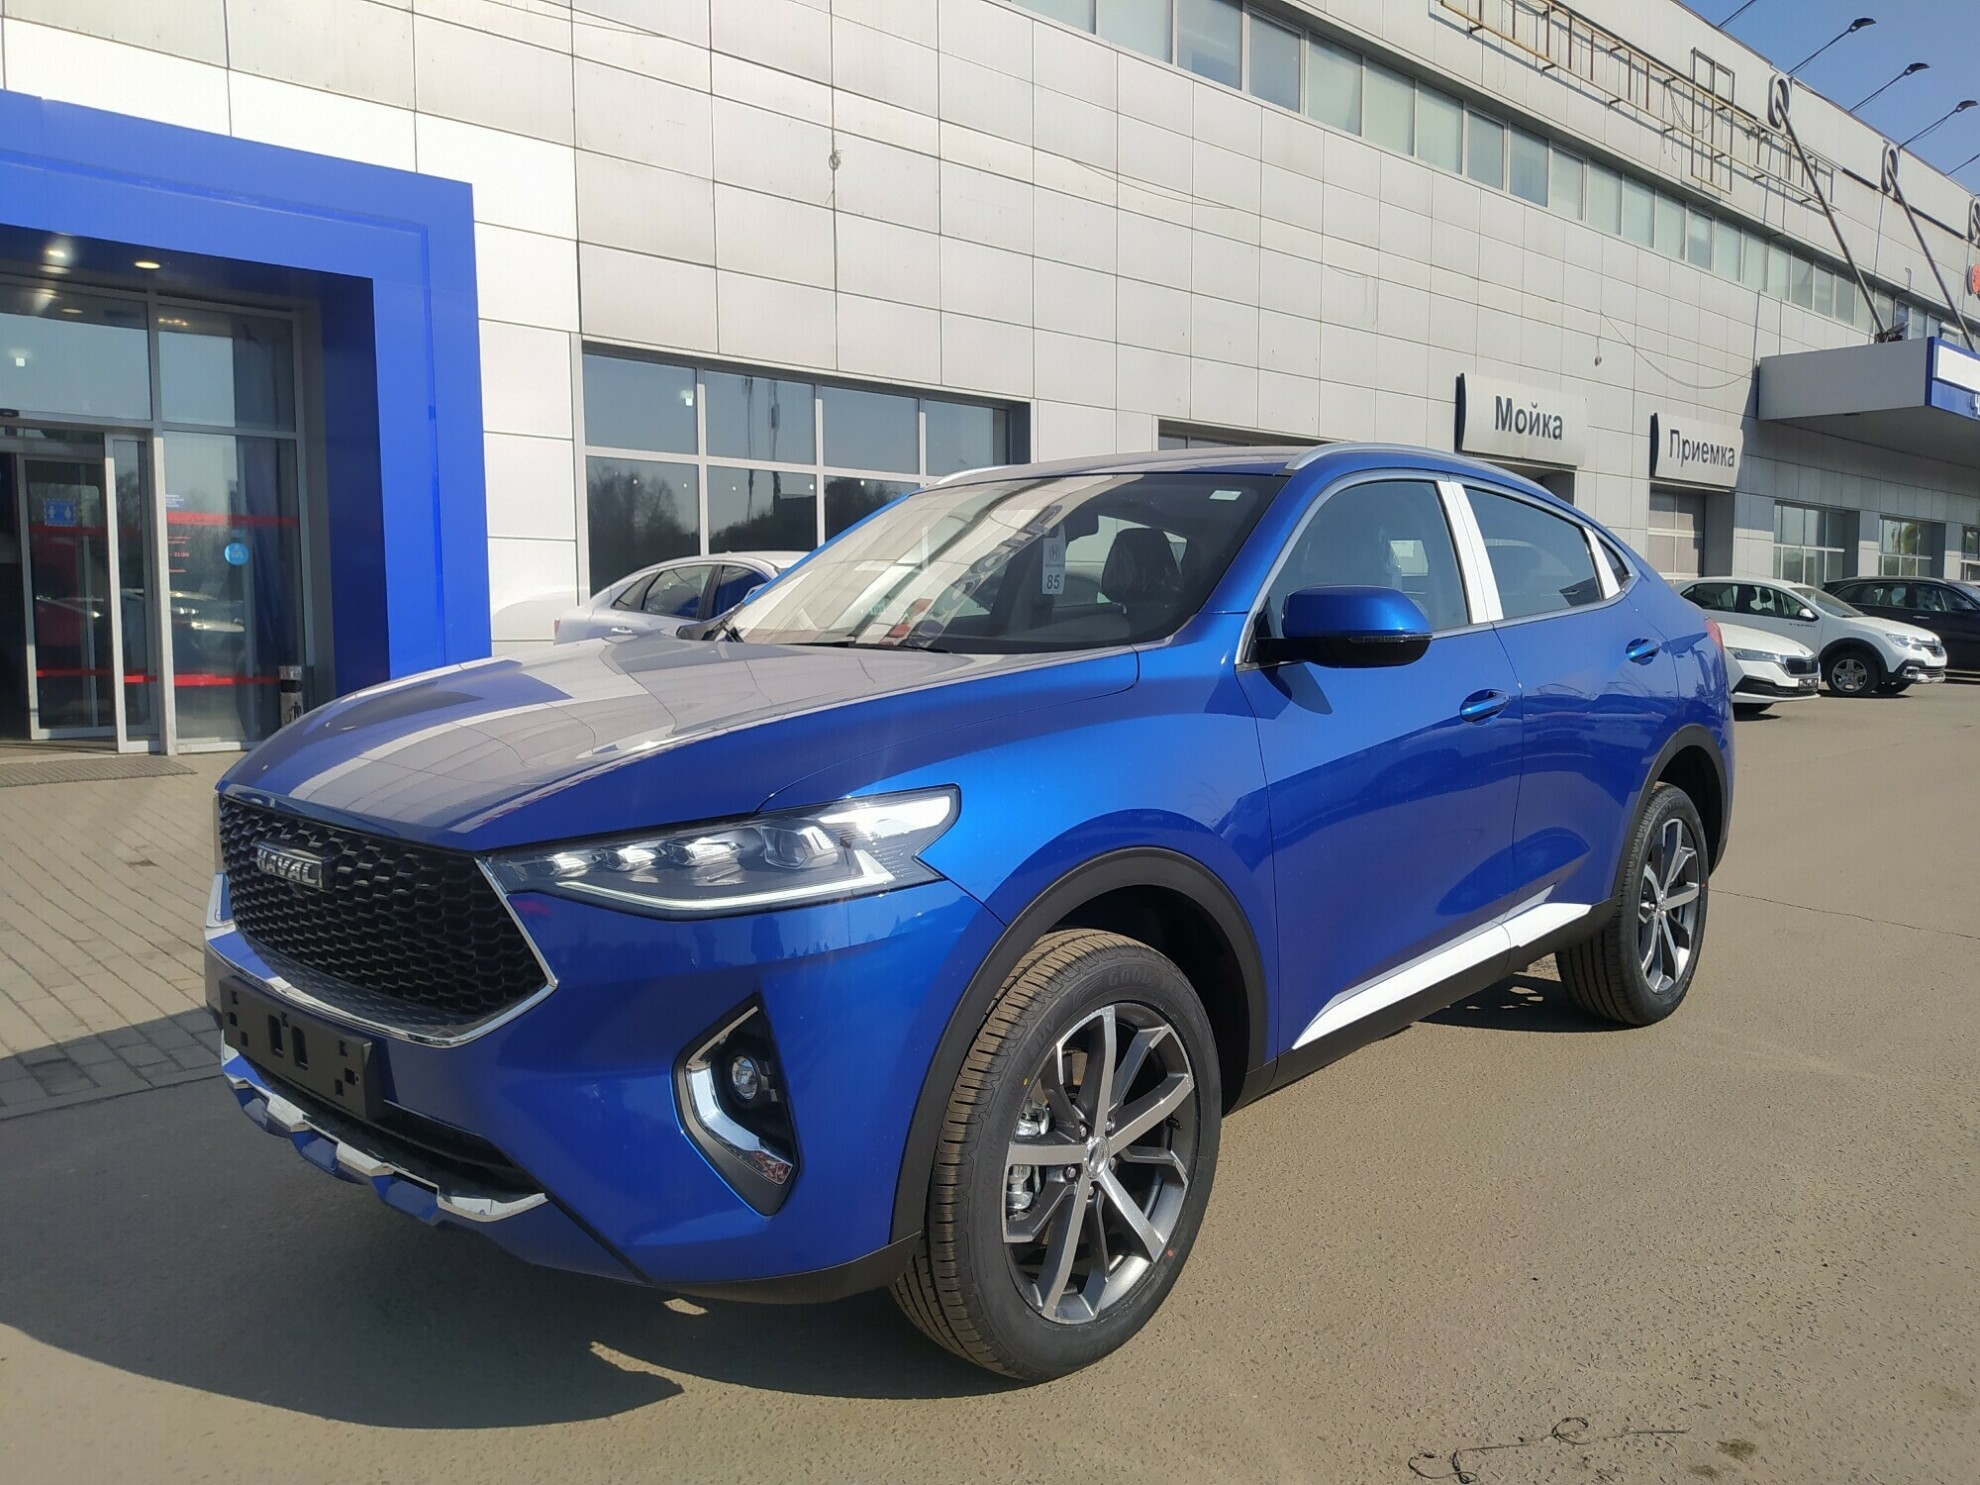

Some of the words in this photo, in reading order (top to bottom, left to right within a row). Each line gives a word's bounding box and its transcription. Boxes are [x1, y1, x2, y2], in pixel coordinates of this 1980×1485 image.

[1494, 395, 1563, 441] Мойка
[1669, 429, 1736, 468] Приемка
[1046, 574, 1060, 590] 85
[257, 848, 318, 885] HAVAL
